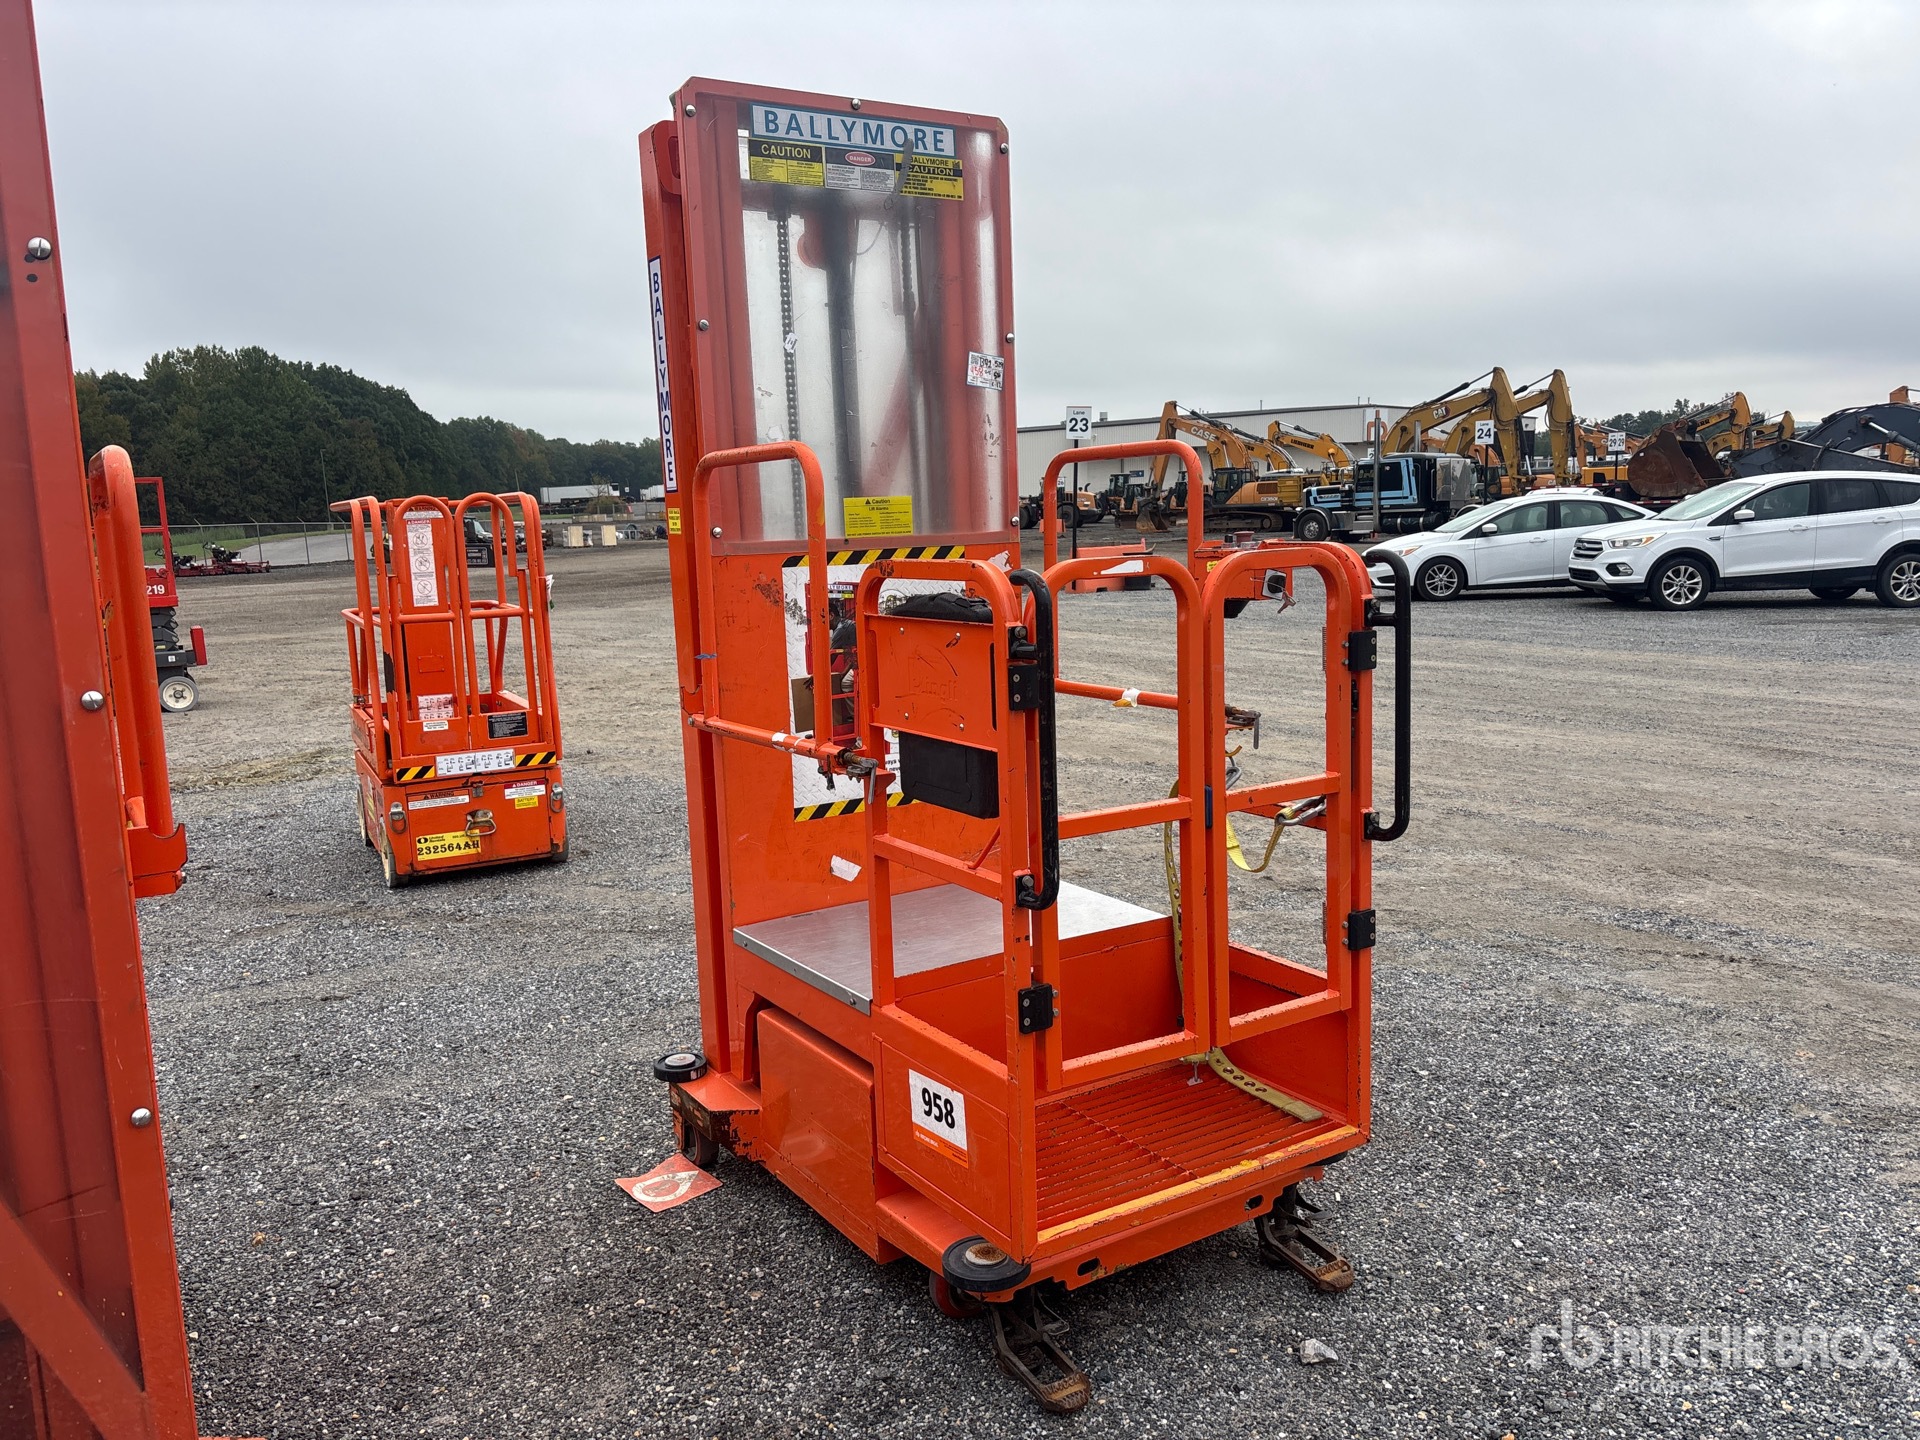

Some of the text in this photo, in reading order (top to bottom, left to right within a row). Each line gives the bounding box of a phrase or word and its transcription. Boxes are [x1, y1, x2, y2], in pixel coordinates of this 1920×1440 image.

[764, 109, 945, 152] BALLYMORE
[761, 144, 811, 159] CAUTION
[908, 165, 954, 176] CAUTION
[653, 272, 675, 482] BALLYMORE
[1433, 406, 1447, 420] CAT
[1069, 417, 1089, 432] 23
[1190, 426, 1217, 442] CASE
[1477, 428, 1492, 440] 24
[146, 585, 165, 595] 219
[430, 791, 455, 799] WARNING
[921, 1087, 955, 1129] 958
